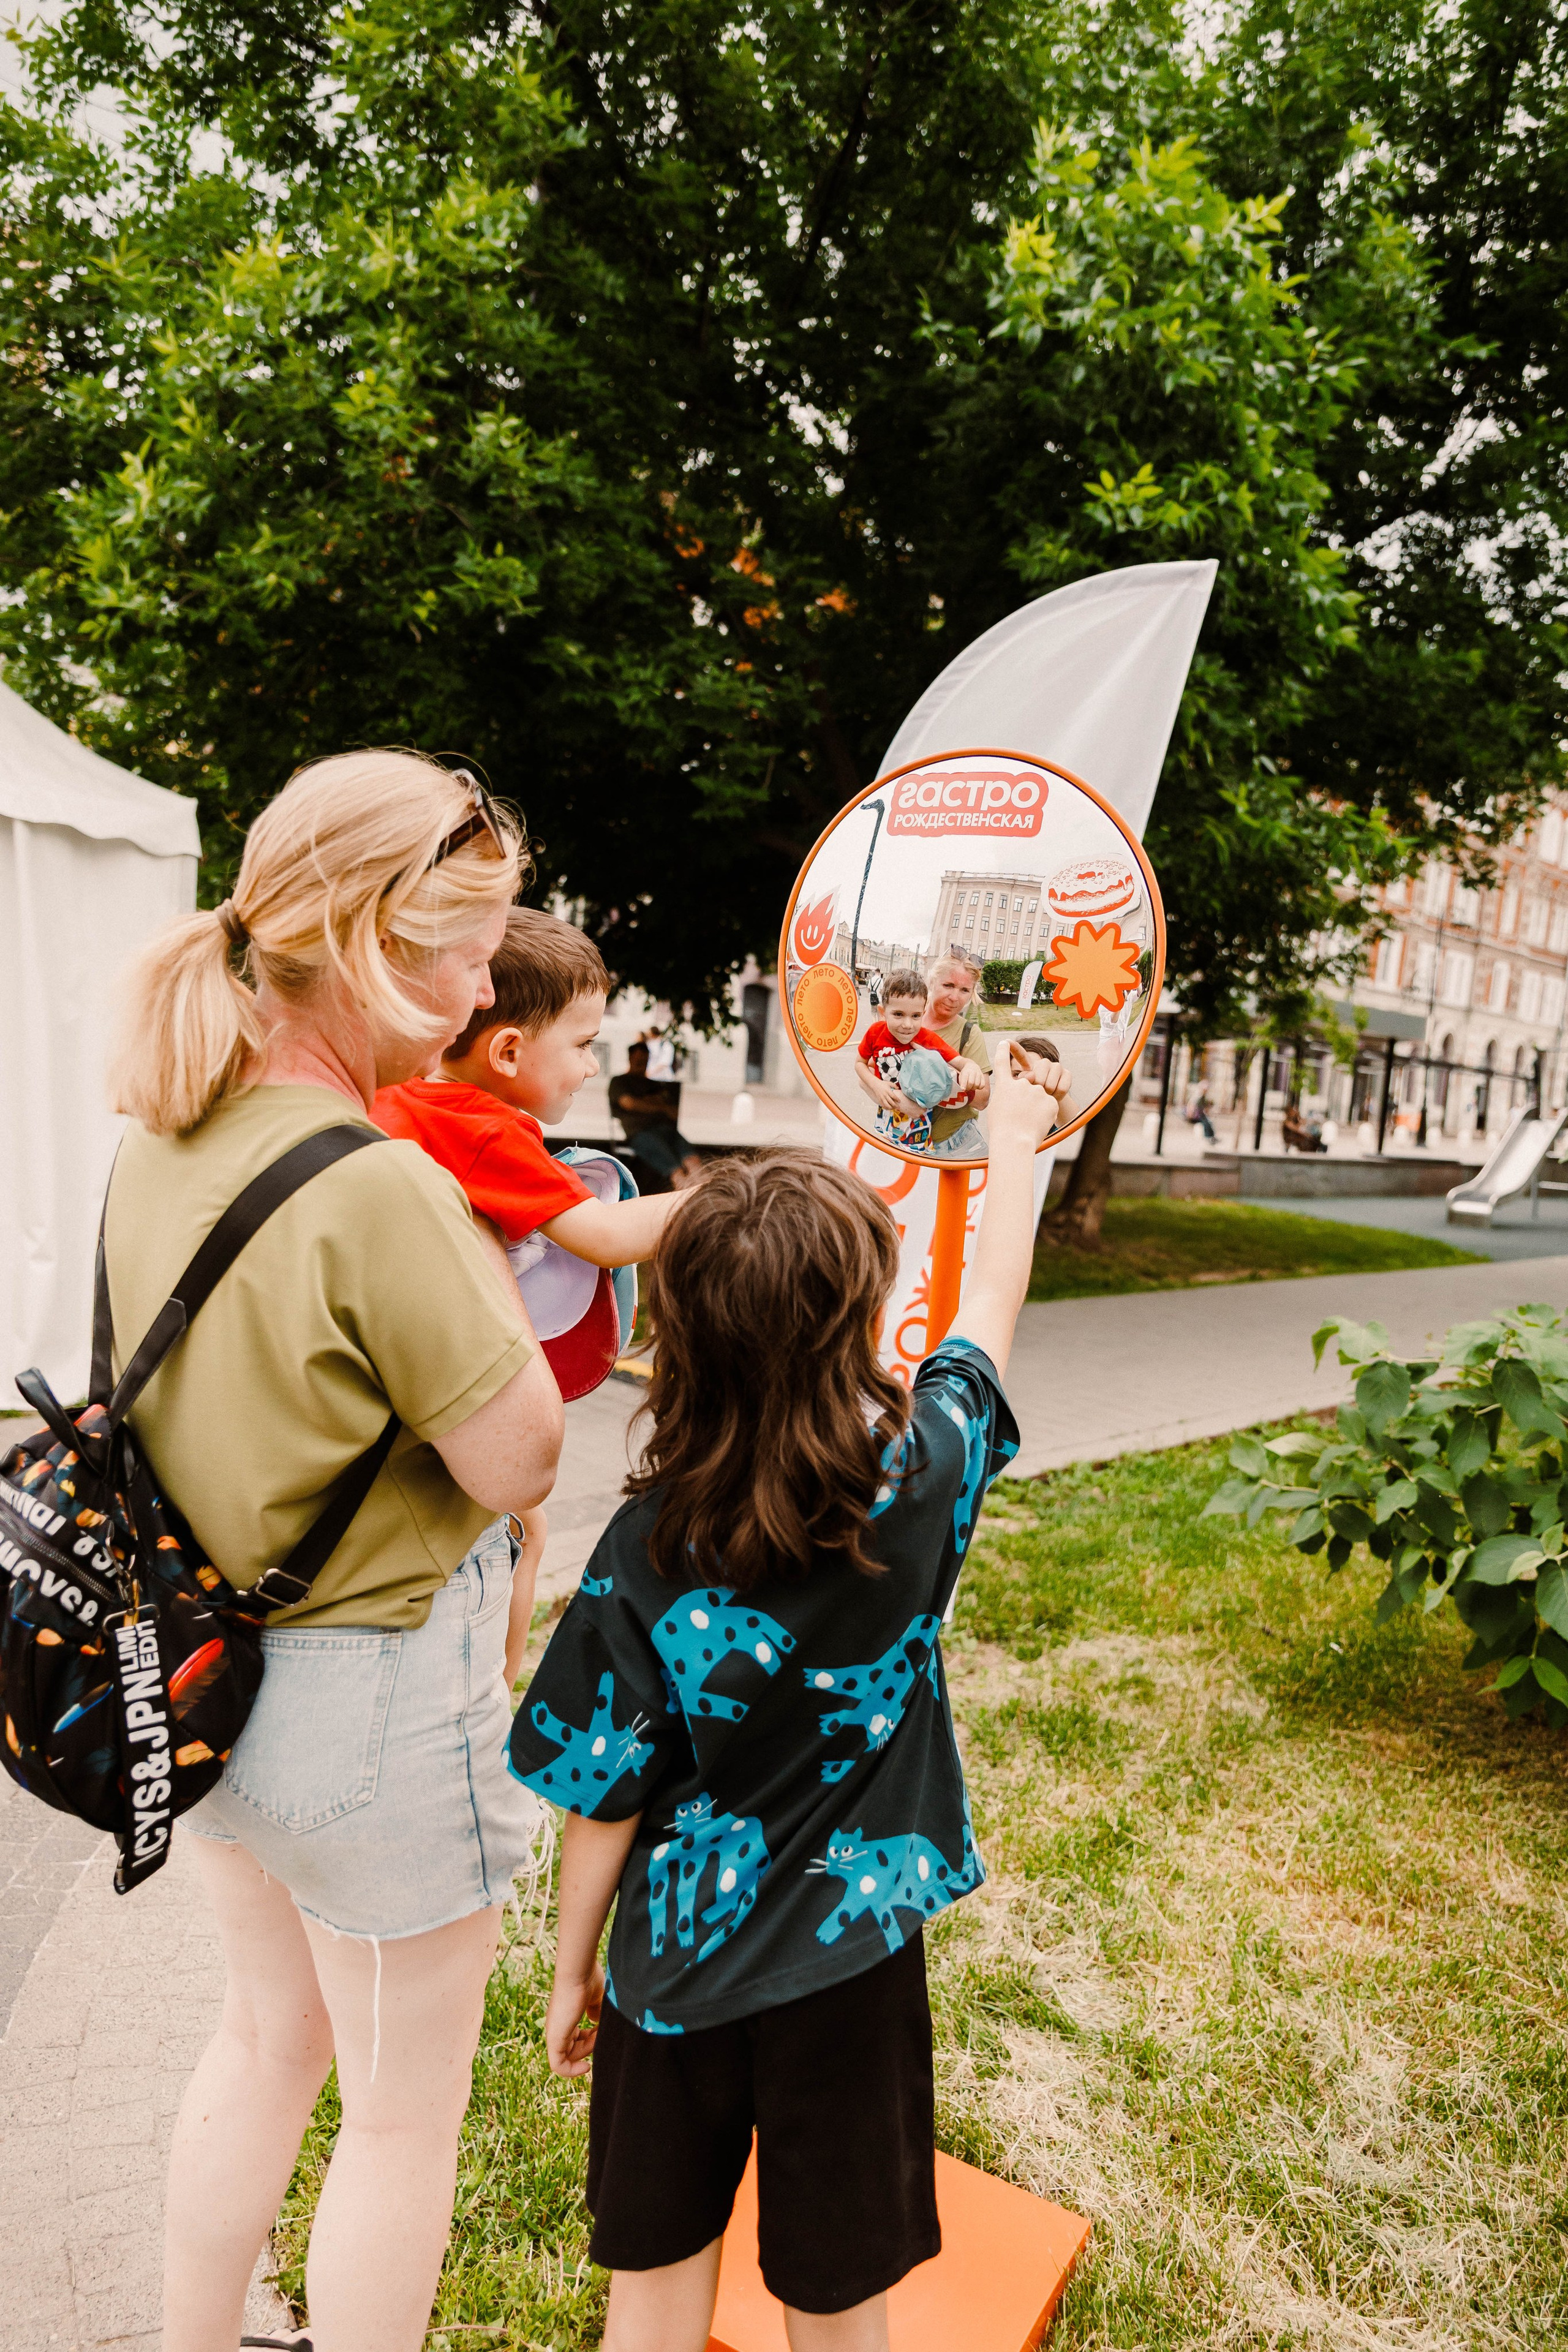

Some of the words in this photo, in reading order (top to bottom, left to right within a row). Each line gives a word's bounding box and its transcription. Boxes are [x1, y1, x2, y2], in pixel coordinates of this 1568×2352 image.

[898, 780, 1040, 810] гастро
[894, 813, 1035, 829] РОЖДЕСТВЕНСКАЯ
[813, 968, 834, 979] лето
[797, 979, 810, 1006] лето
[837, 976, 853, 1004] лето
[797, 1013, 813, 1039] лето
[841, 1007, 854, 1036] лето
[817, 1036, 839, 1047] лето
